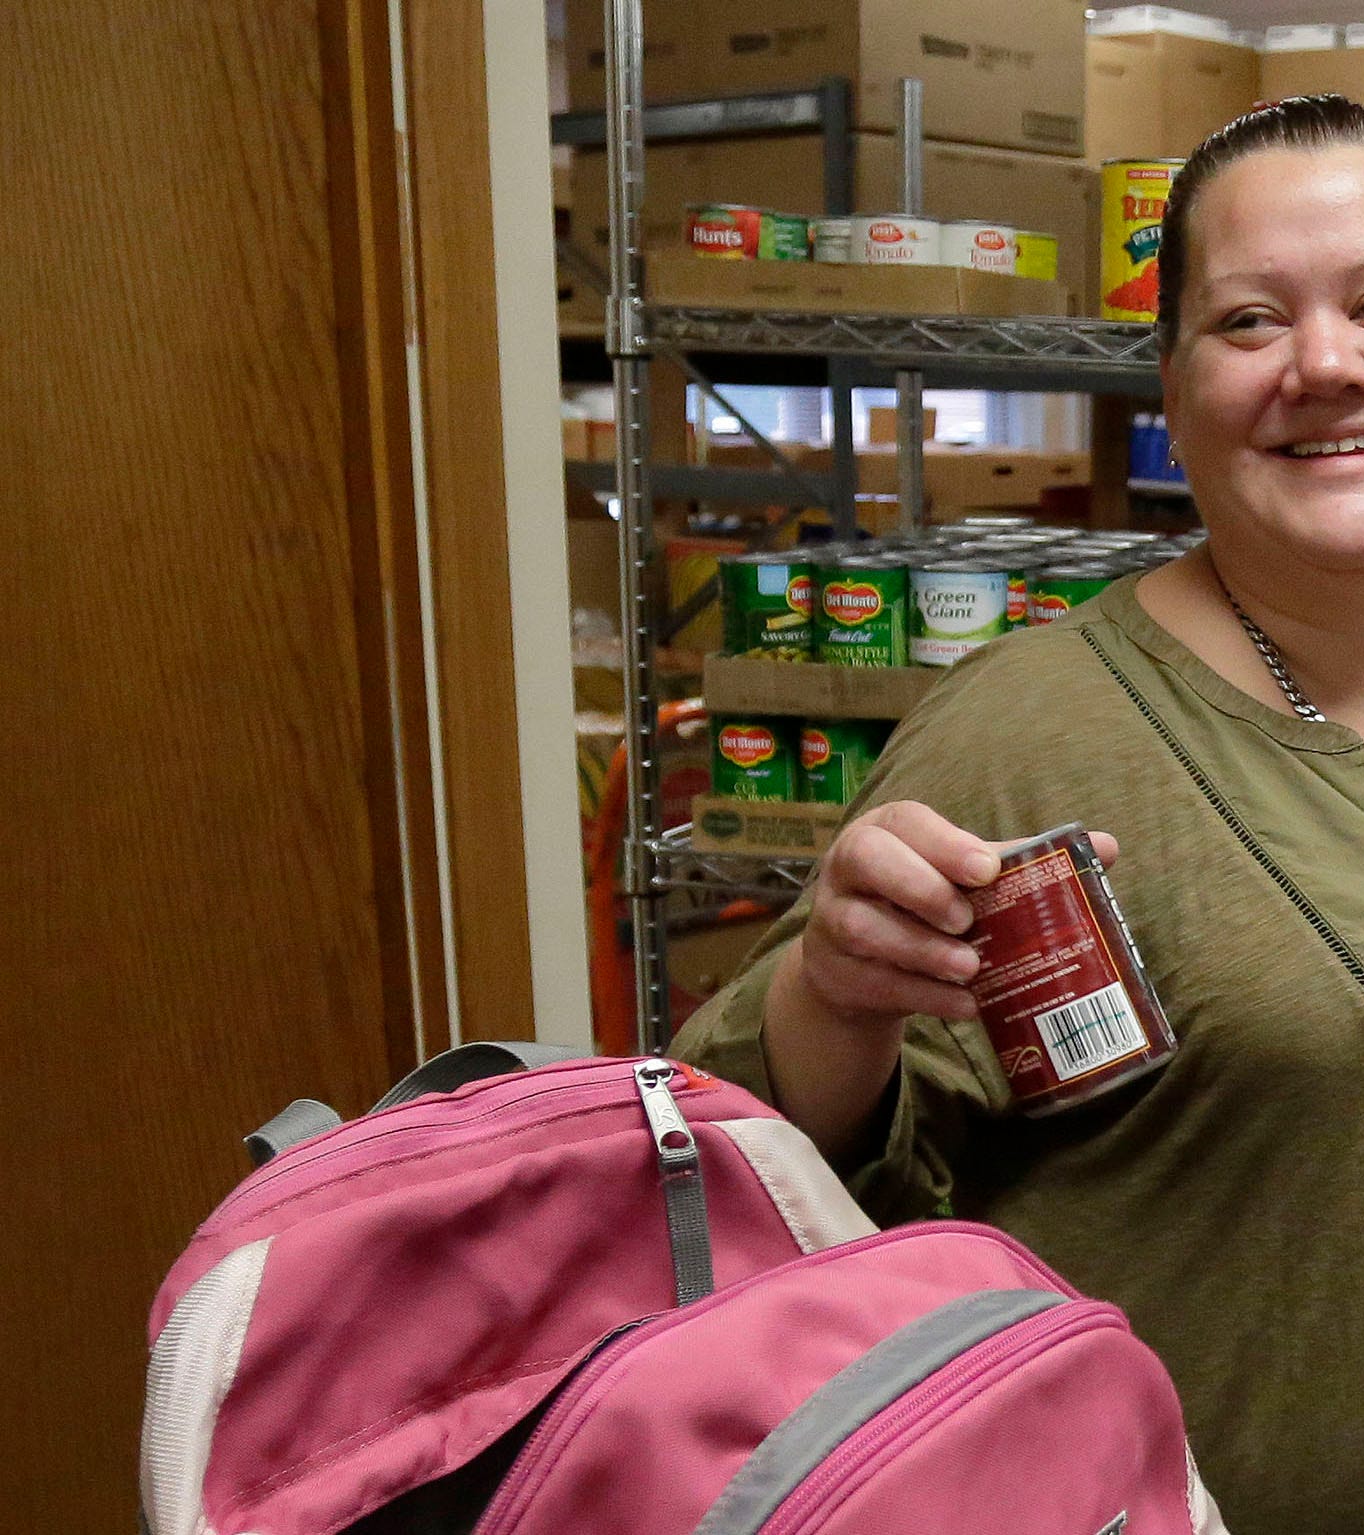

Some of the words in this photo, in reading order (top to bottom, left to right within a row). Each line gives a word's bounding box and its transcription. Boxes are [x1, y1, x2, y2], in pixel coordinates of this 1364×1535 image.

[842, 593, 878, 608] Monte
[924, 587, 977, 605] Green
[926, 603, 974, 619] Giant
